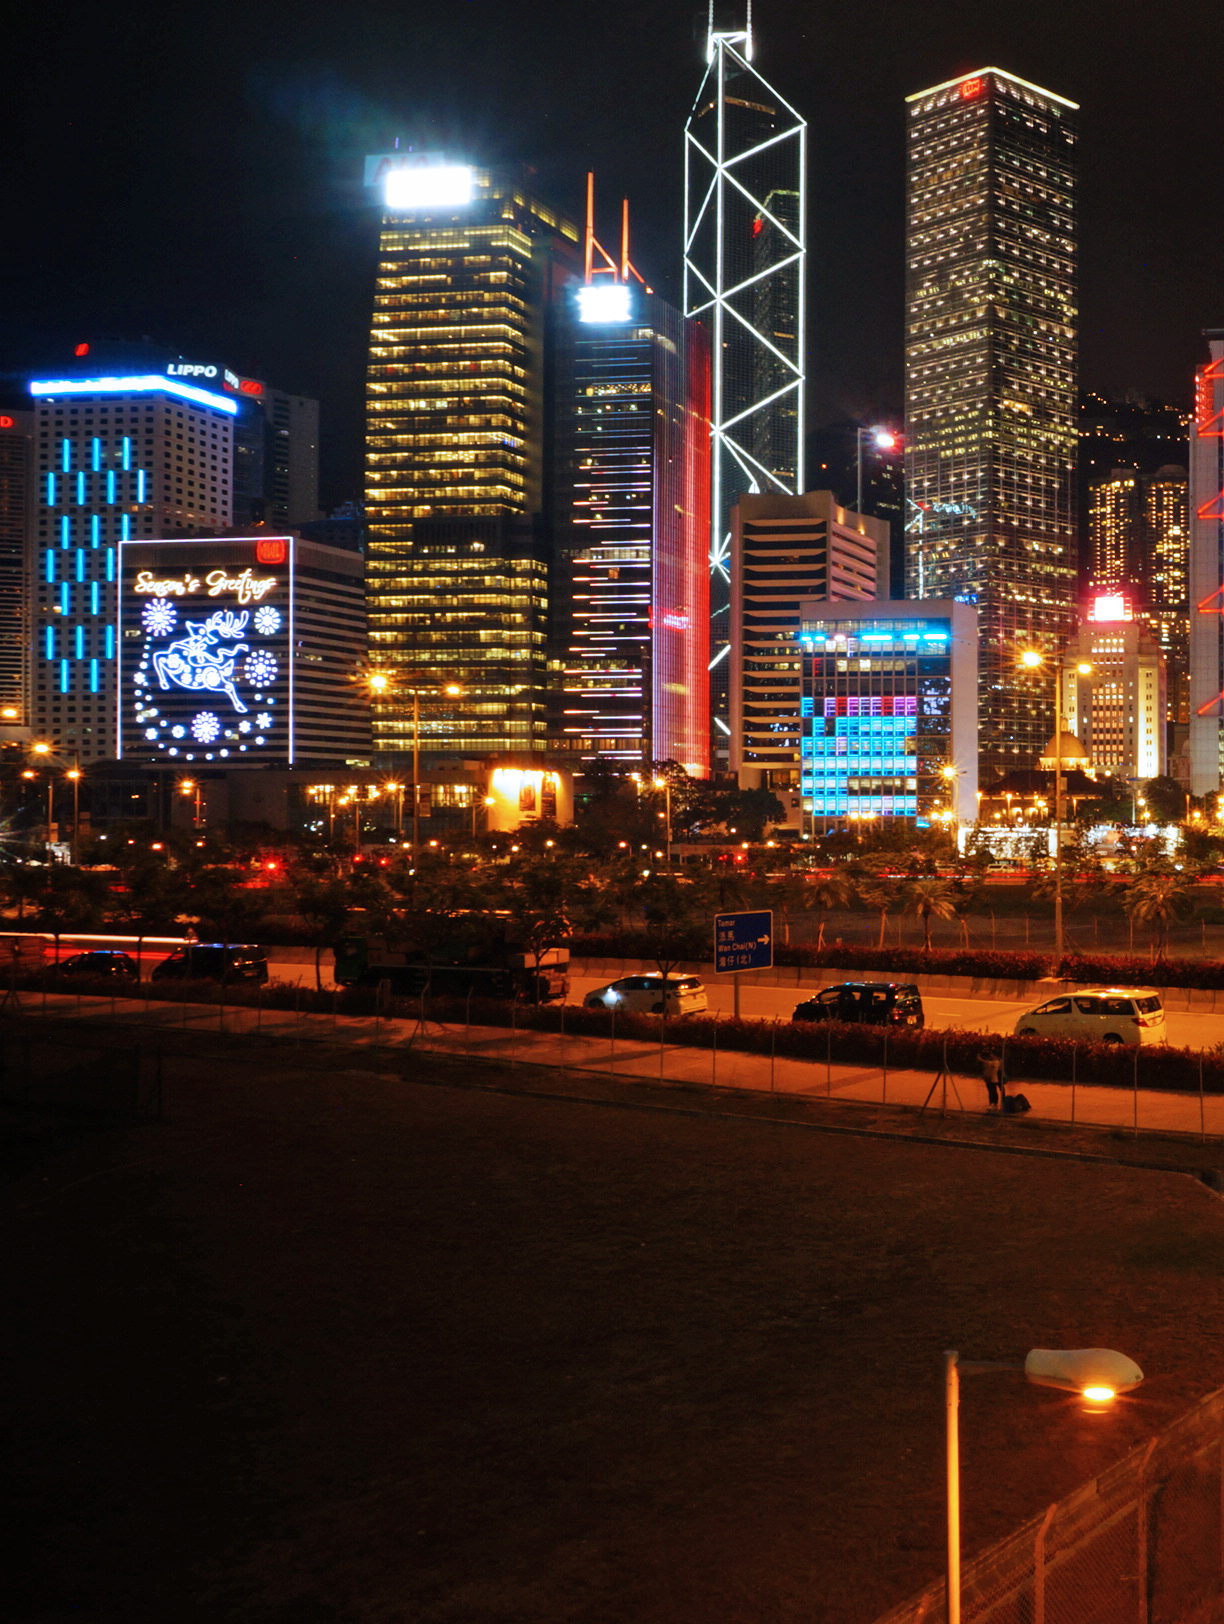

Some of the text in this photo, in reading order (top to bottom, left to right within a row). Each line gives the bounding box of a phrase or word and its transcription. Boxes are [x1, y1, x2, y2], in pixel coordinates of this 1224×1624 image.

[166, 363, 218, 378] LIPPO
[134, 568, 277, 604] Season's Greetings
[718, 919, 736, 927] Tamar
[718, 944, 731, 952] Wan
